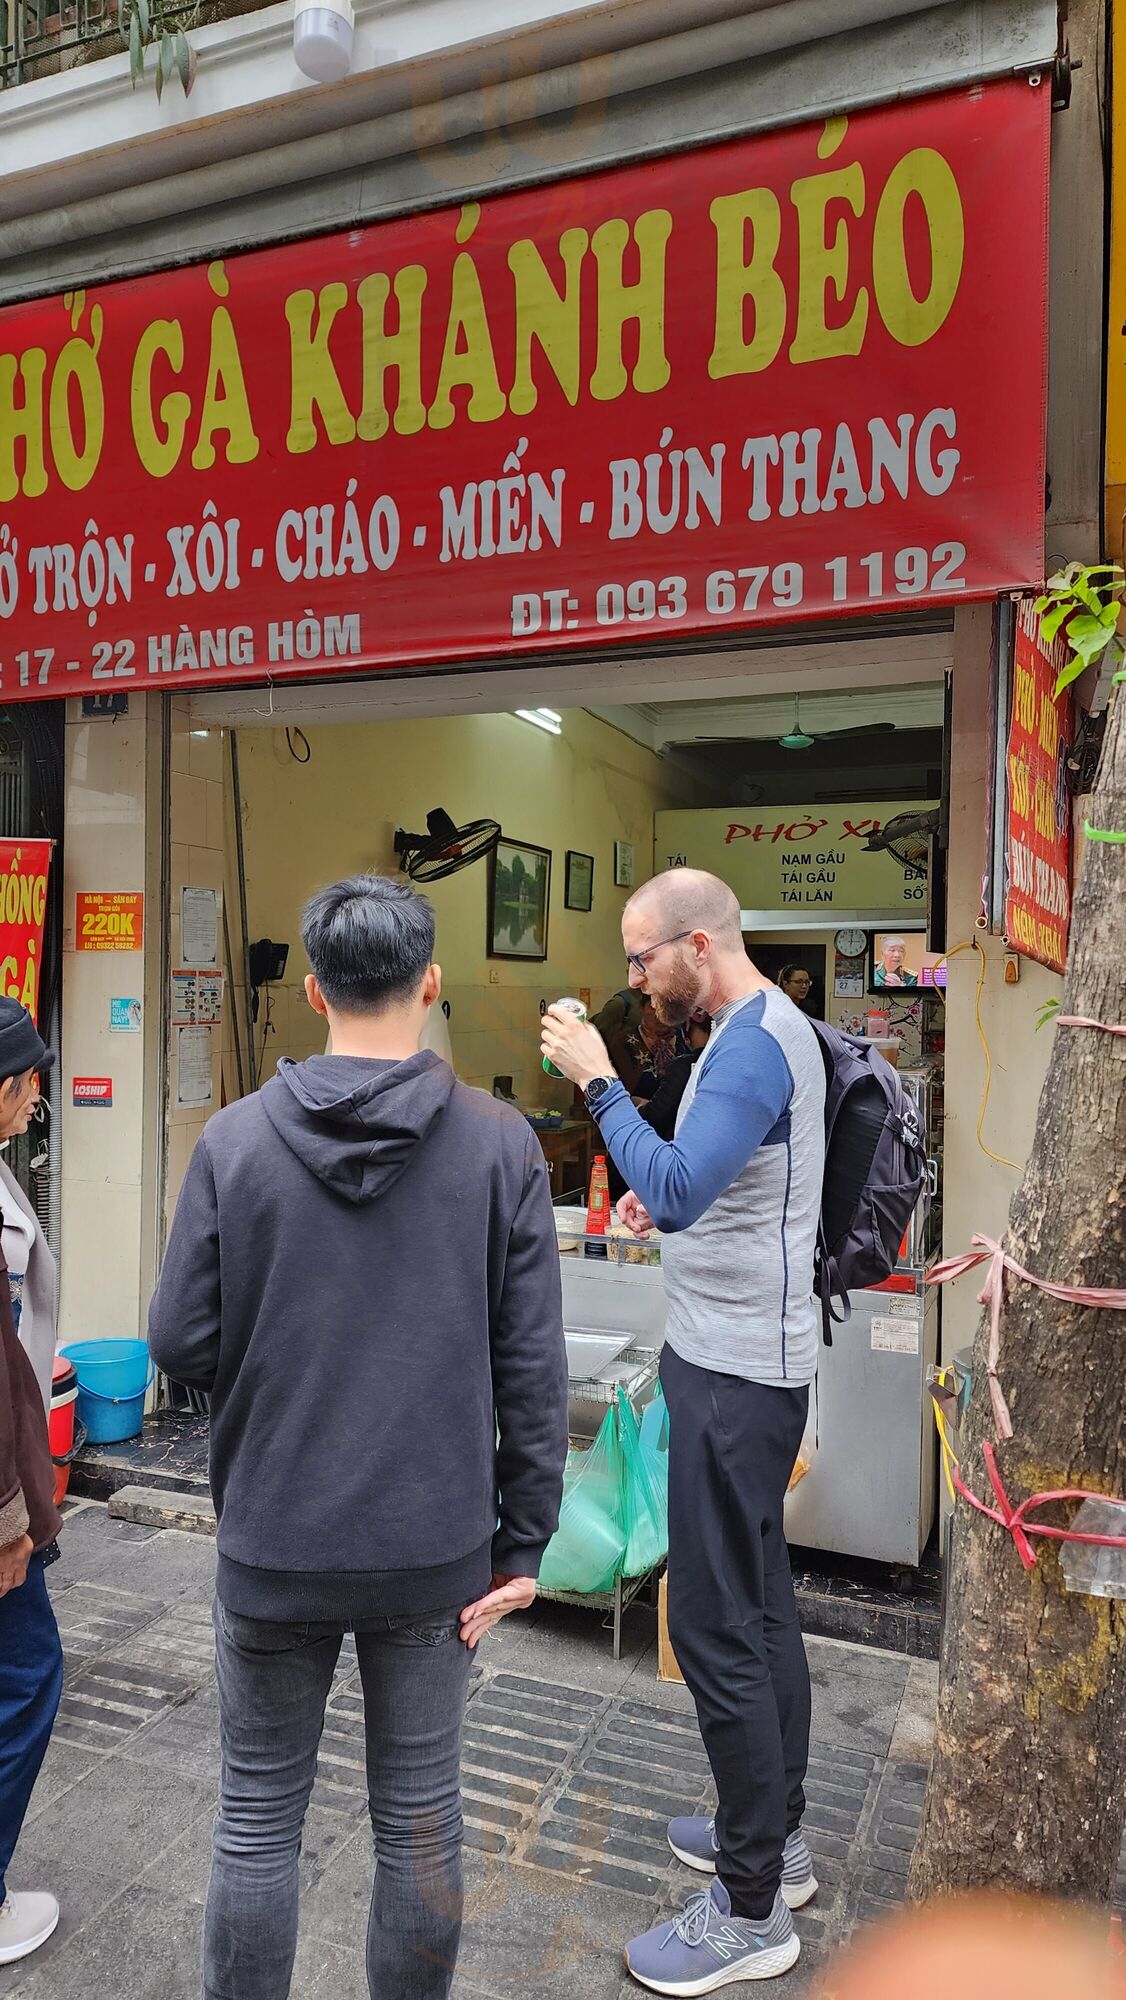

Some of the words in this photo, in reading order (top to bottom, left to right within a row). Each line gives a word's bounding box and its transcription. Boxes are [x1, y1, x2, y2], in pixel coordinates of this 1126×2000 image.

[131, 260, 259, 478] GÀ
[285, 201, 672, 454] KHÁNH
[708, 116, 965, 380] BÉO
[28, 518, 135, 628] TRỘN
[166, 500, 241, 597] XÔI
[276, 478, 401, 583] CHÁO
[439, 437, 566, 563] MIẾN
[608, 427, 727, 540] BÚN
[742, 407, 961, 522] THANG
[510, 587, 579, 636] ĐT:
[596, 575, 688, 626] 093
[705, 561, 804, 615] 679
[823, 540, 967, 600] 1192
[15, 648, 55, 687] 17
[92, 639, 136, 679] 22
[148, 624, 255, 674] HÀNG
[267, 609, 362, 662] HÒM
[724, 815, 829, 844] PHỞ
[666, 852, 688, 867] TÁI
[781, 853, 812, 868] NẠM
[815, 848, 846, 865] GẦU
[0, 848, 46, 927] ỐNG
[781, 869, 803, 884] TÁI
[806, 867, 836, 883] GẦU
[780, 888, 802, 903] TÁI
[805, 889, 834, 903] LĂN
[82, 912, 136, 936] 220K
[74, 1085, 110, 1096] LOSHIP
